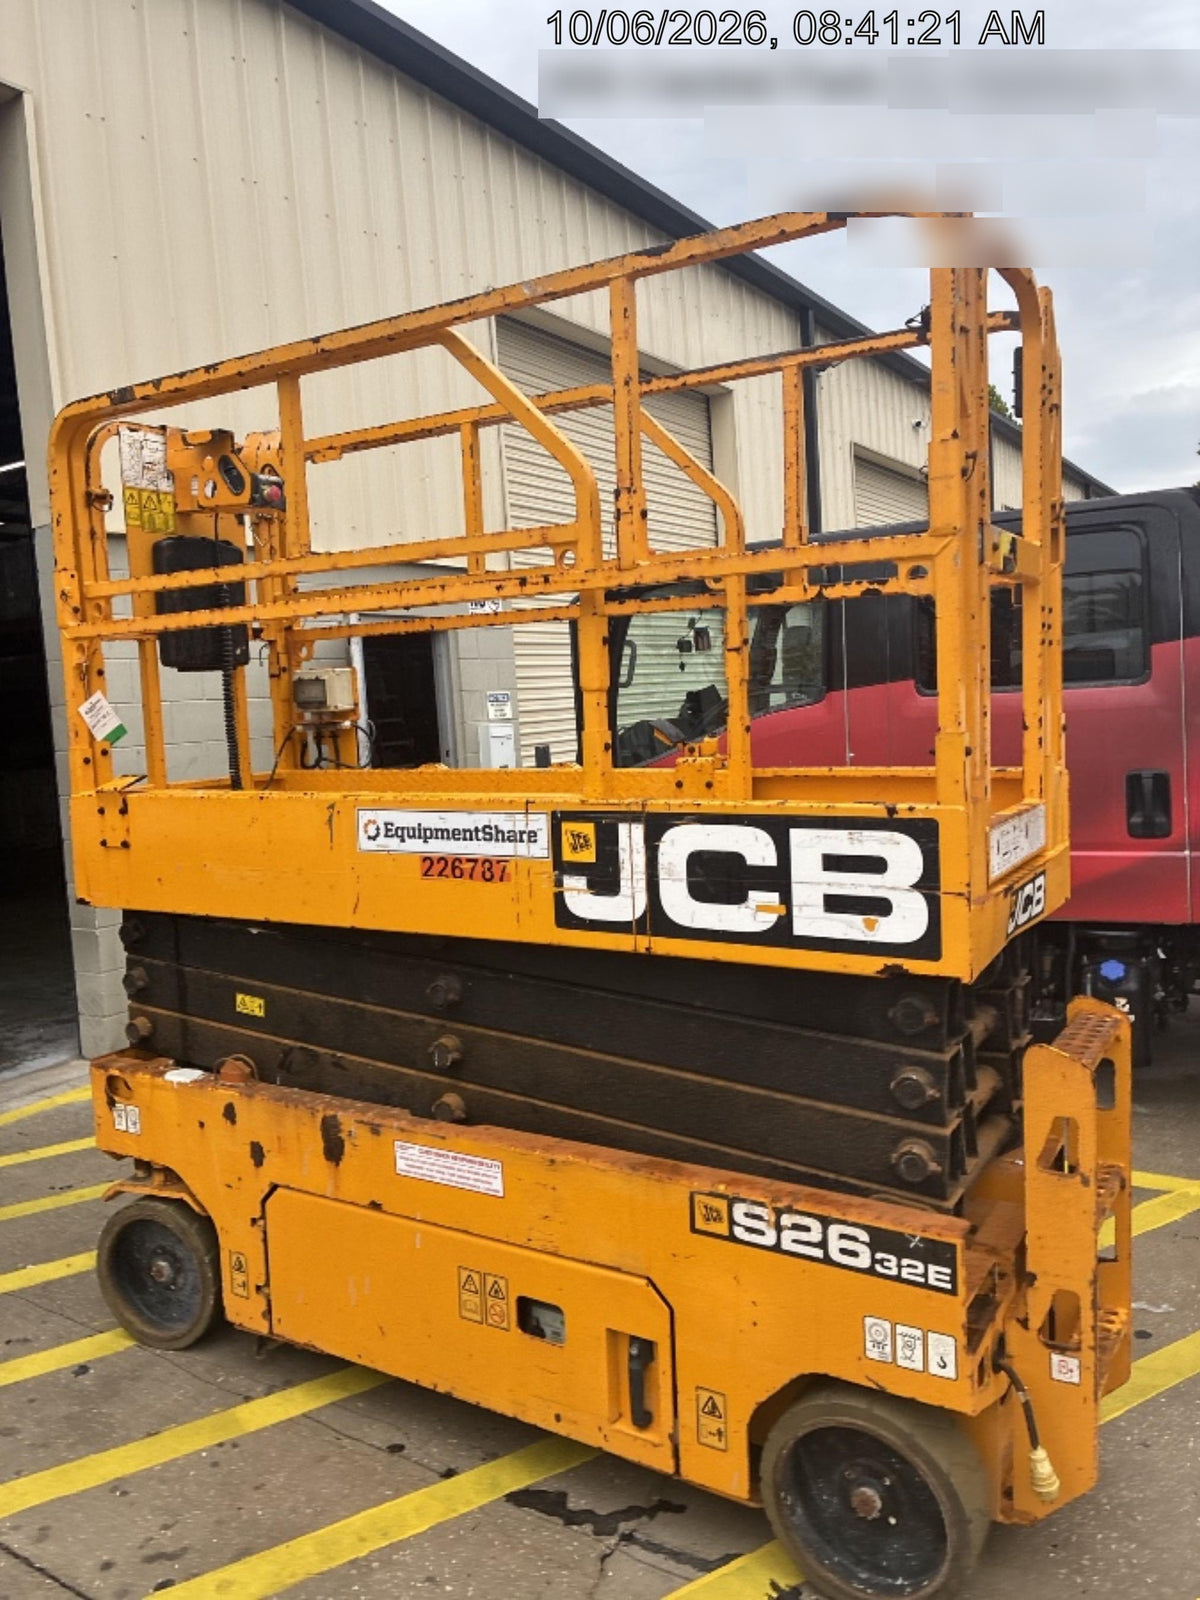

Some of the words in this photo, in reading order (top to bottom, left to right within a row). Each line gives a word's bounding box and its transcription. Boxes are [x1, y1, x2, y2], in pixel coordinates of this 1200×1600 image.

[383, 822, 538, 844] EquipmentShare
[422, 857, 510, 881] 226787
[563, 822, 929, 943] JCB
[1007, 875, 1045, 934] JCB
[731, 1202, 872, 1269] S26
[874, 1253, 952, 1289] 32E
